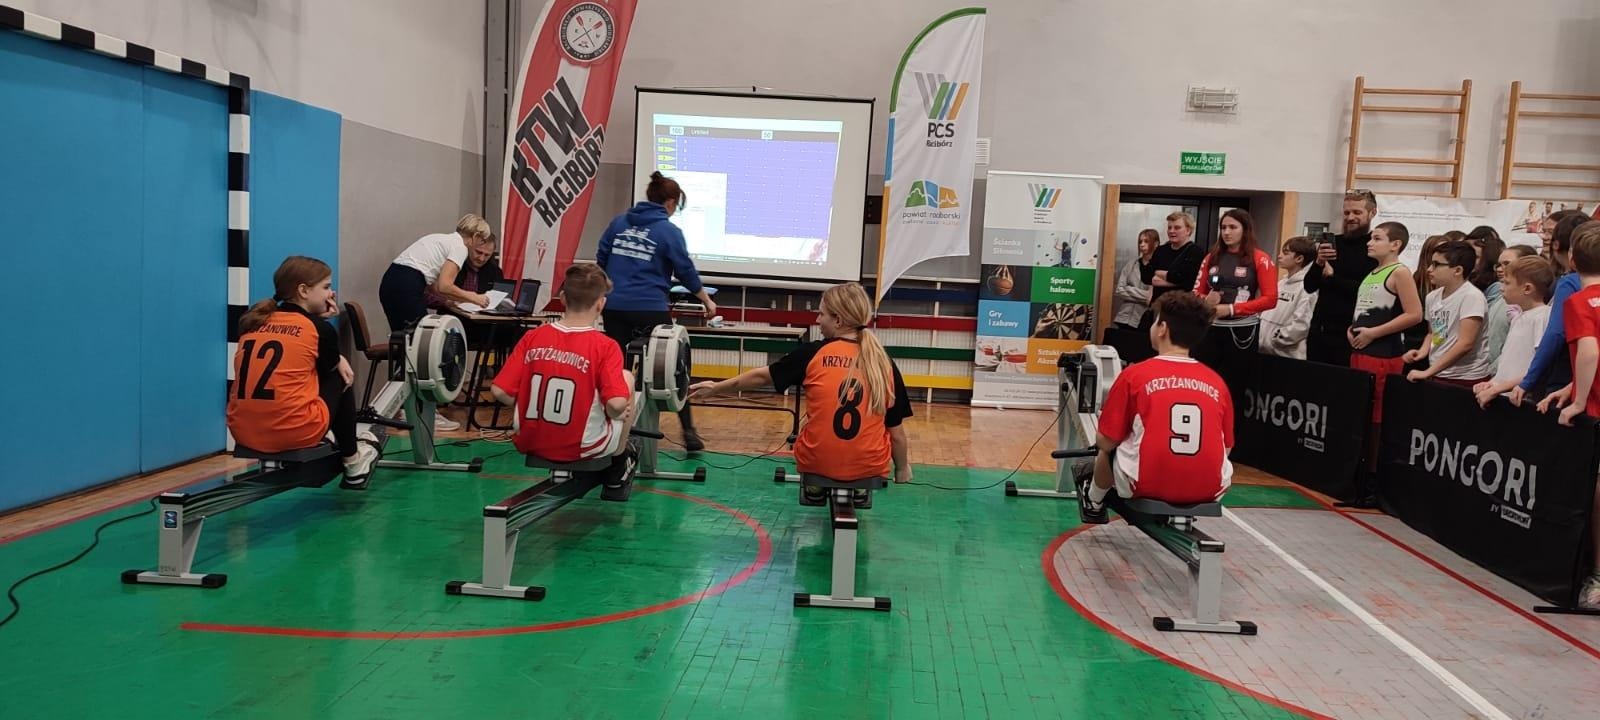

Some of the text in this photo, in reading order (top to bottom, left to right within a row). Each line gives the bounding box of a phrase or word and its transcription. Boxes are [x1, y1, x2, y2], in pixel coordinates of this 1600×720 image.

[928, 122, 954, 138] PCS
[534, 125, 605, 228] RACIBÓRZ
[1050, 276, 1075, 286] Sporty
[1050, 285, 1076, 294] halowe
[989, 310, 1002, 318] Gry
[237, 339, 284, 400] 12
[524, 345, 590, 374] KRZYŻANOWICE
[524, 372, 577, 426] 10
[832, 378, 864, 441] 8
[1144, 375, 1220, 402] KRZYŻANOWICE
[1244, 388, 1328, 439] ONGORI
[1169, 402, 1203, 457] 9
[1408, 428, 1538, 510] PONGORI
